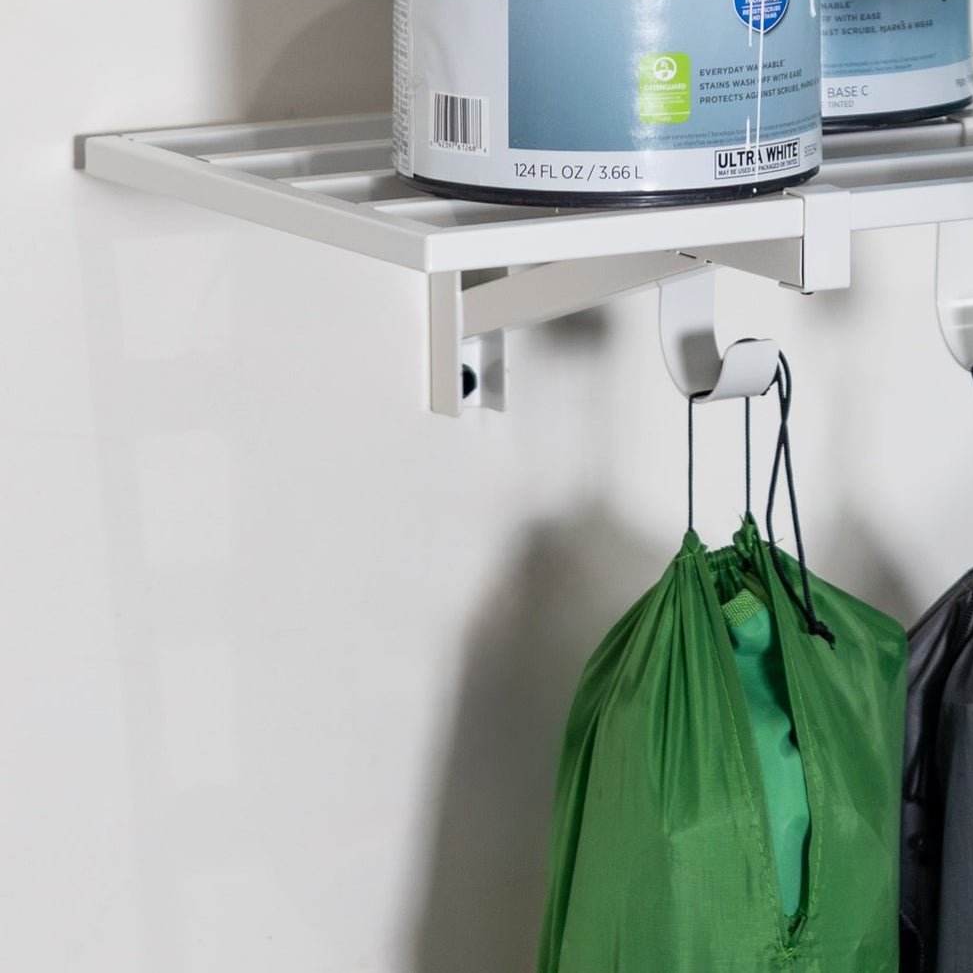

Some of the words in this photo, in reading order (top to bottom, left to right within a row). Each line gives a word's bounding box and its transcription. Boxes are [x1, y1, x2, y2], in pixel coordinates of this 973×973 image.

[834, 13, 858, 22] WITH
[859, 11, 882, 21] EASE
[699, 65, 744, 77] EVERYDAY
[699, 80, 730, 91] STAINS
[732, 78, 756, 88] WASH
[772, 73, 788, 82] WITH
[789, 68, 802, 79] EASE
[827, 85, 858, 99] BASE
[861, 84, 869, 96] C
[699, 93, 744, 104] PROTECTS
[828, 100, 855, 108] TINTED
[766, 141, 798, 162] WHITE
[513, 163, 537, 178] 124
[540, 164, 557, 179] FL
[561, 165, 584, 179] OZ
[586, 164, 596, 181] /
[599, 165, 631, 180] 3.66
[635, 165, 643, 179] L
